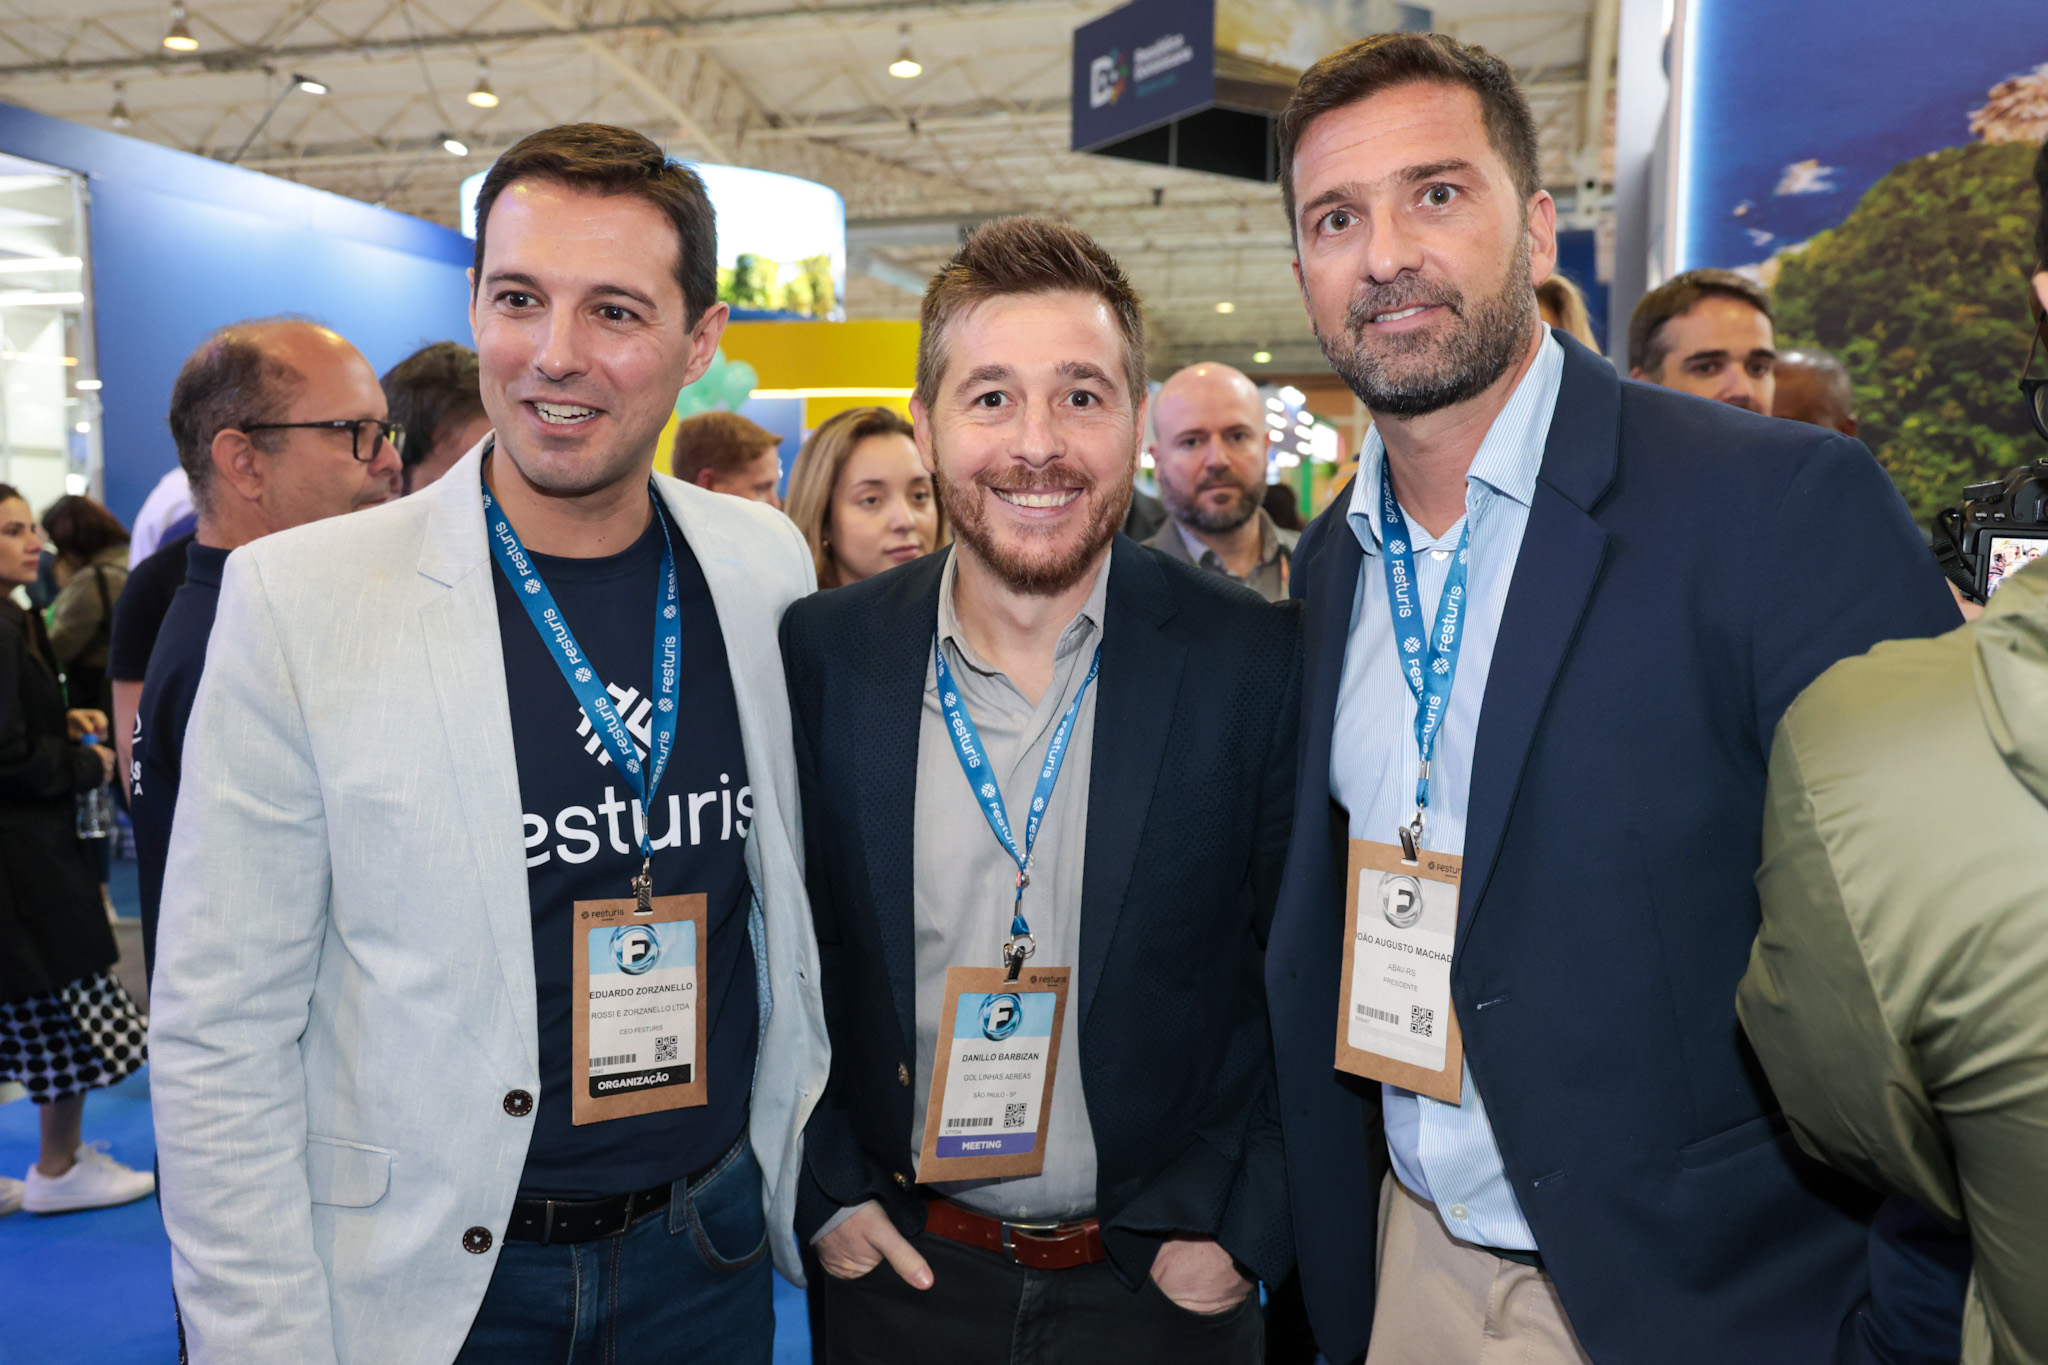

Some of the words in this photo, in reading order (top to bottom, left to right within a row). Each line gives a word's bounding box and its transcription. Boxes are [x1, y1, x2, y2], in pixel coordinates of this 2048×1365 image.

[495, 521, 532, 577] Festuris
[1392, 559, 1414, 618] Festuris
[1438, 585, 1462, 652] Festuris
[543, 608, 582, 665] Festuris
[661, 635, 676, 693] Festuris
[595, 697, 632, 756] Festuris
[949, 710, 981, 769] Festuris
[1043, 720, 1068, 779] Festuris
[521, 773, 755, 869] esturis
[1436, 863, 1462, 875] Festur
[591, 909, 625, 919] Festuris
[1356, 931, 1374, 943] OÃO
[1375, 936, 1414, 954] AUGUSTO
[1415, 947, 1453, 963] MACHAD
[1038, 975, 1067, 984] Festuris
[1383, 976, 1418, 993] PRESIDENTE
[589, 987, 634, 1000] EDUARDO
[635, 982, 693, 996] ZORZANELLO
[591, 1010, 615, 1020] ROSSI
[616, 1009, 622, 1017] E
[623, 1004, 671, 1017] ZORZANELLO
[672, 1003, 690, 1012] LTDA
[619, 1027, 633, 1035] CEO
[634, 1025, 663, 1034] FESTURIS
[961, 1053, 997, 1063] DANILLO
[998, 1052, 1040, 1062] BARBIZAN
[597, 1072, 670, 1091] ORGANIZAÇÃO
[963, 1074, 977, 1082] GOL
[978, 1073, 1004, 1081] LINHAS
[1005, 1072, 1032, 1080] AEREAS
[972, 1091, 985, 1099] SÃO
[961, 1139, 1002, 1151] MEETING
